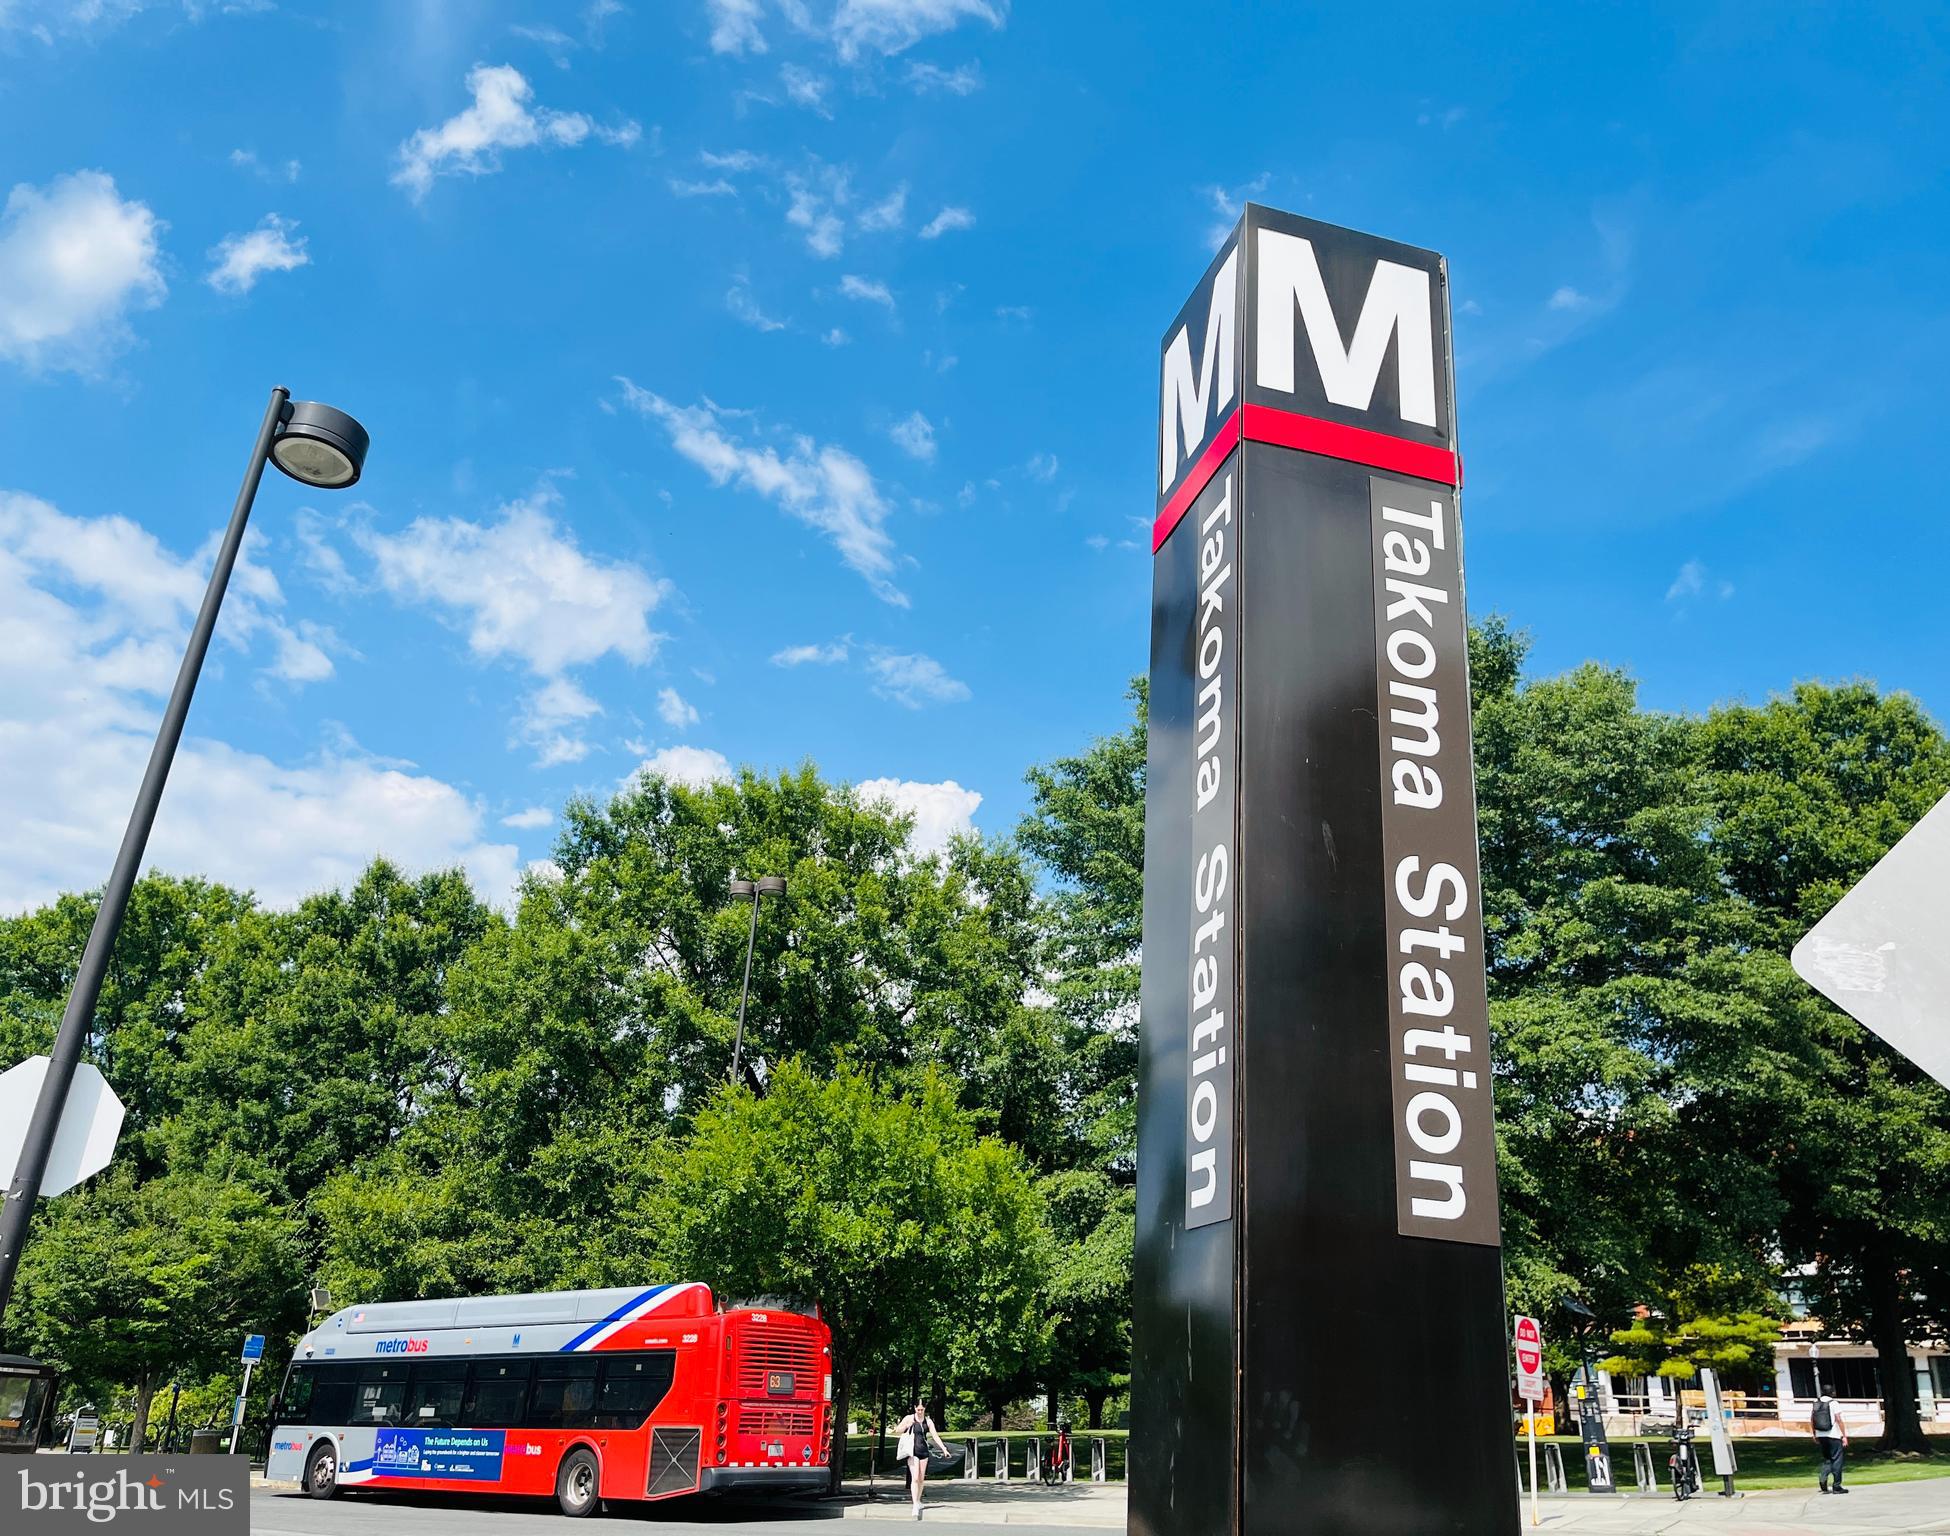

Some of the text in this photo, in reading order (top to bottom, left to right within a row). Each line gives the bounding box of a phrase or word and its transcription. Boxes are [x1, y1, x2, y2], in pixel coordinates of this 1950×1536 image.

[1161, 243, 1239, 496] M
[1257, 227, 1437, 428] M
[1190, 474, 1232, 1209] Takoma Station
[1381, 501, 1478, 1220] Takoma Station
[376, 1336, 429, 1353] metrobus
[770, 1375, 781, 1388] 63
[275, 1441, 303, 1451] metrobus
[424, 1436, 434, 1446] The
[434, 1437, 451, 1446] Future
[451, 1437, 473, 1448] Depends
[481, 1437, 489, 1447] Us
